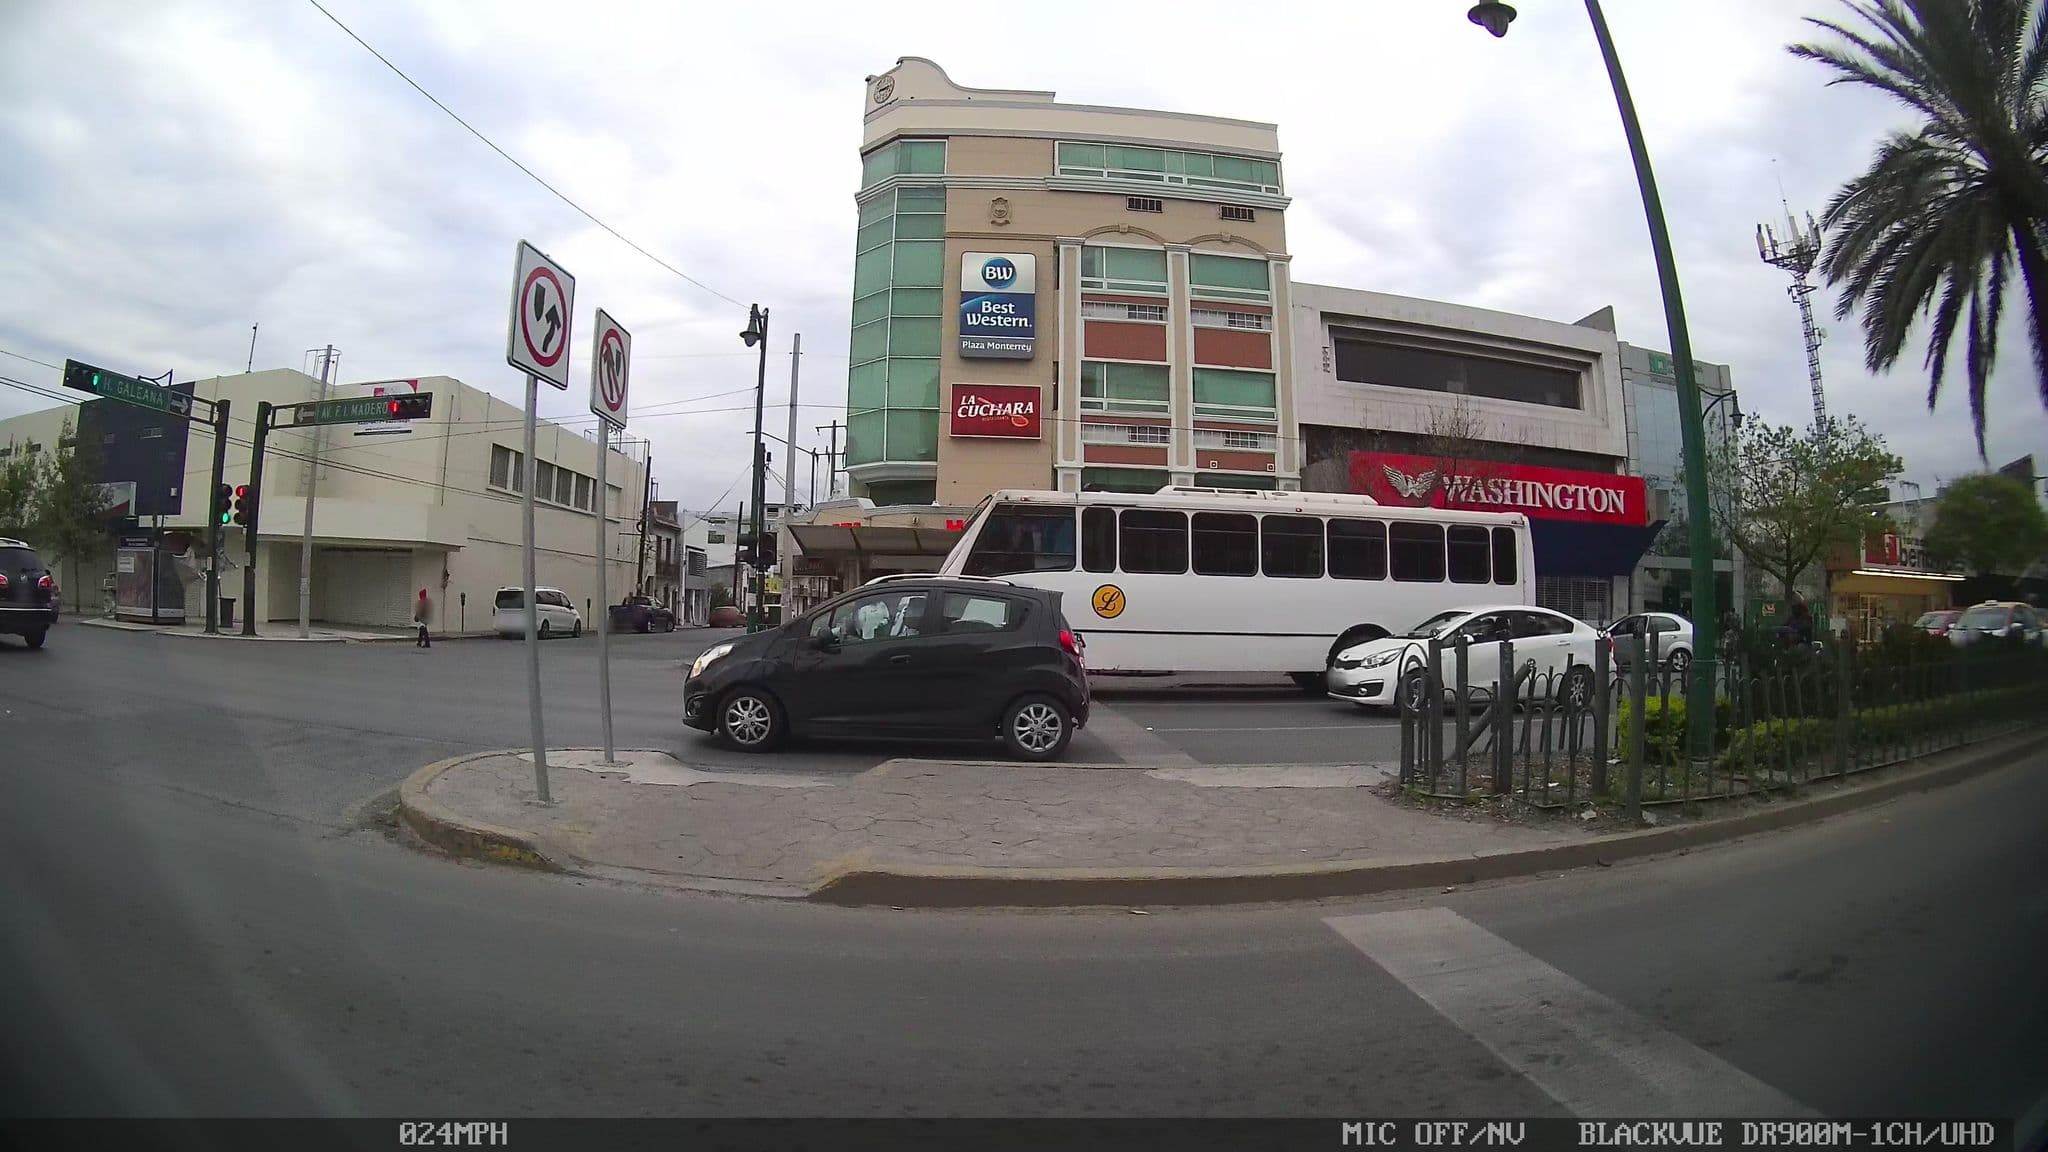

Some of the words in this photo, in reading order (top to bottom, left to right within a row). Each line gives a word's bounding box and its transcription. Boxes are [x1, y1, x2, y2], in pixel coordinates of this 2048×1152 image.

[985, 266, 1013, 280] BW
[981, 300, 1016, 314] Best
[962, 340, 985, 350] Plaza
[987, 342, 1032, 353] Monterrey
[117, 380, 165, 406] GALEANA
[960, 395, 976, 406] LA
[351, 401, 388, 417] MADERO
[957, 402, 1034, 418] CUCHARA
[1443, 475, 1625, 515] WASHINGTON
